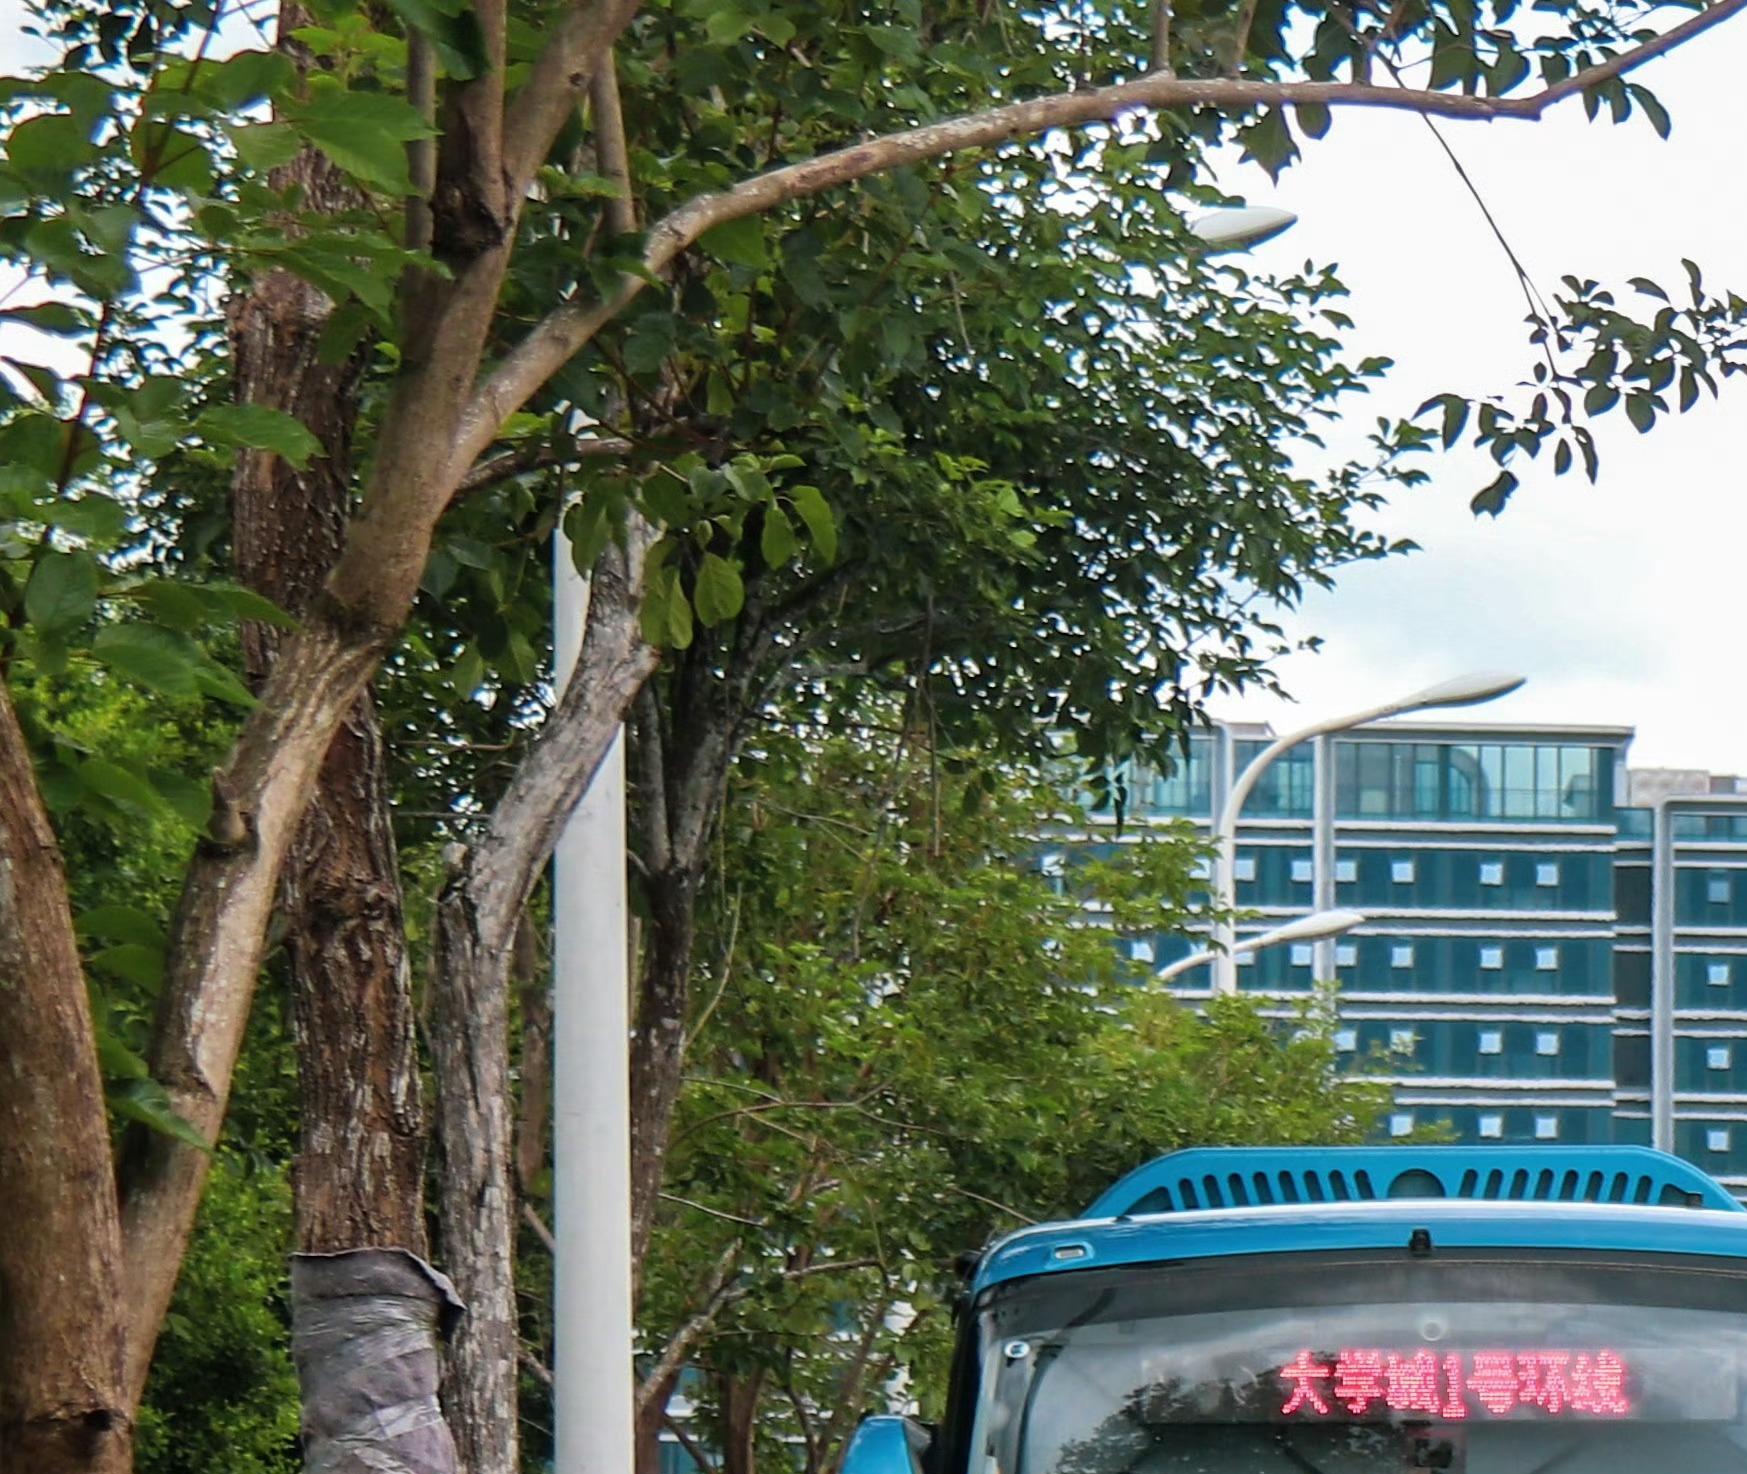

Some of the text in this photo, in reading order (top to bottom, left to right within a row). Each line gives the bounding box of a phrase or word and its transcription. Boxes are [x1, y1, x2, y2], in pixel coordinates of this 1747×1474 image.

[1279, 1348, 1628, 1419] 大学城1号环线
